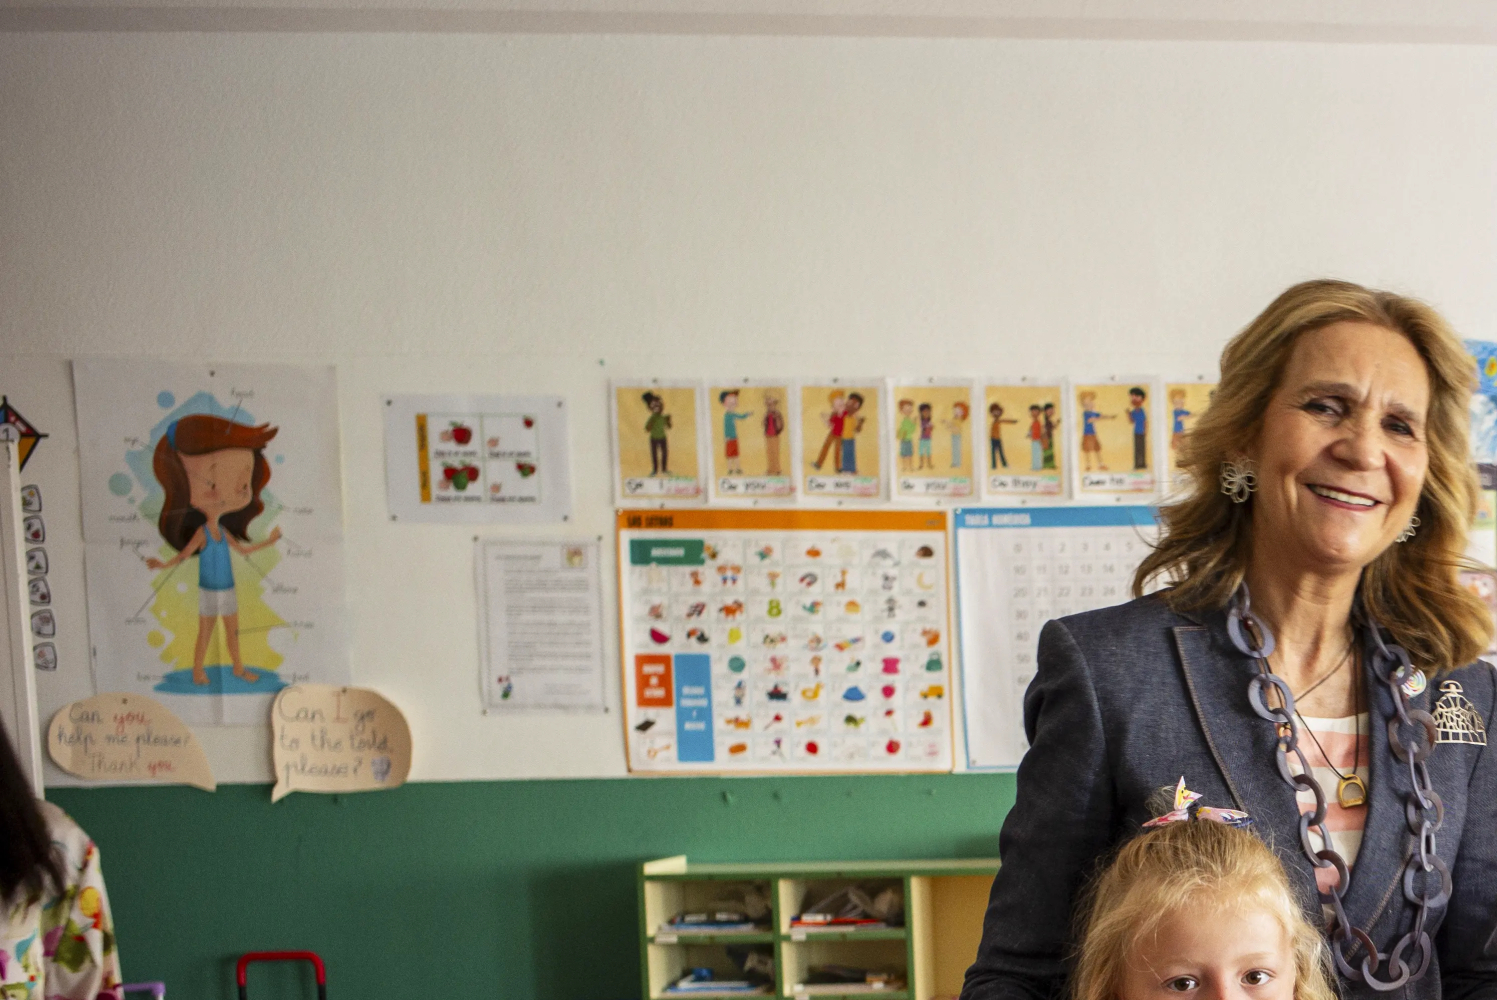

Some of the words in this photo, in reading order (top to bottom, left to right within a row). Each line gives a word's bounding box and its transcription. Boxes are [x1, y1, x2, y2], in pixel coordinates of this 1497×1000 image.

[69, 702, 103, 724] Can
[113, 710, 150, 735] you
[279, 686, 325, 723] Can
[332, 690, 348, 723] I
[57, 724, 95, 753] help
[105, 733, 127, 745] me
[280, 725, 300, 751] to
[310, 725, 342, 752] the
[88, 752, 140, 773] Thank
[147, 758, 177, 778] you
